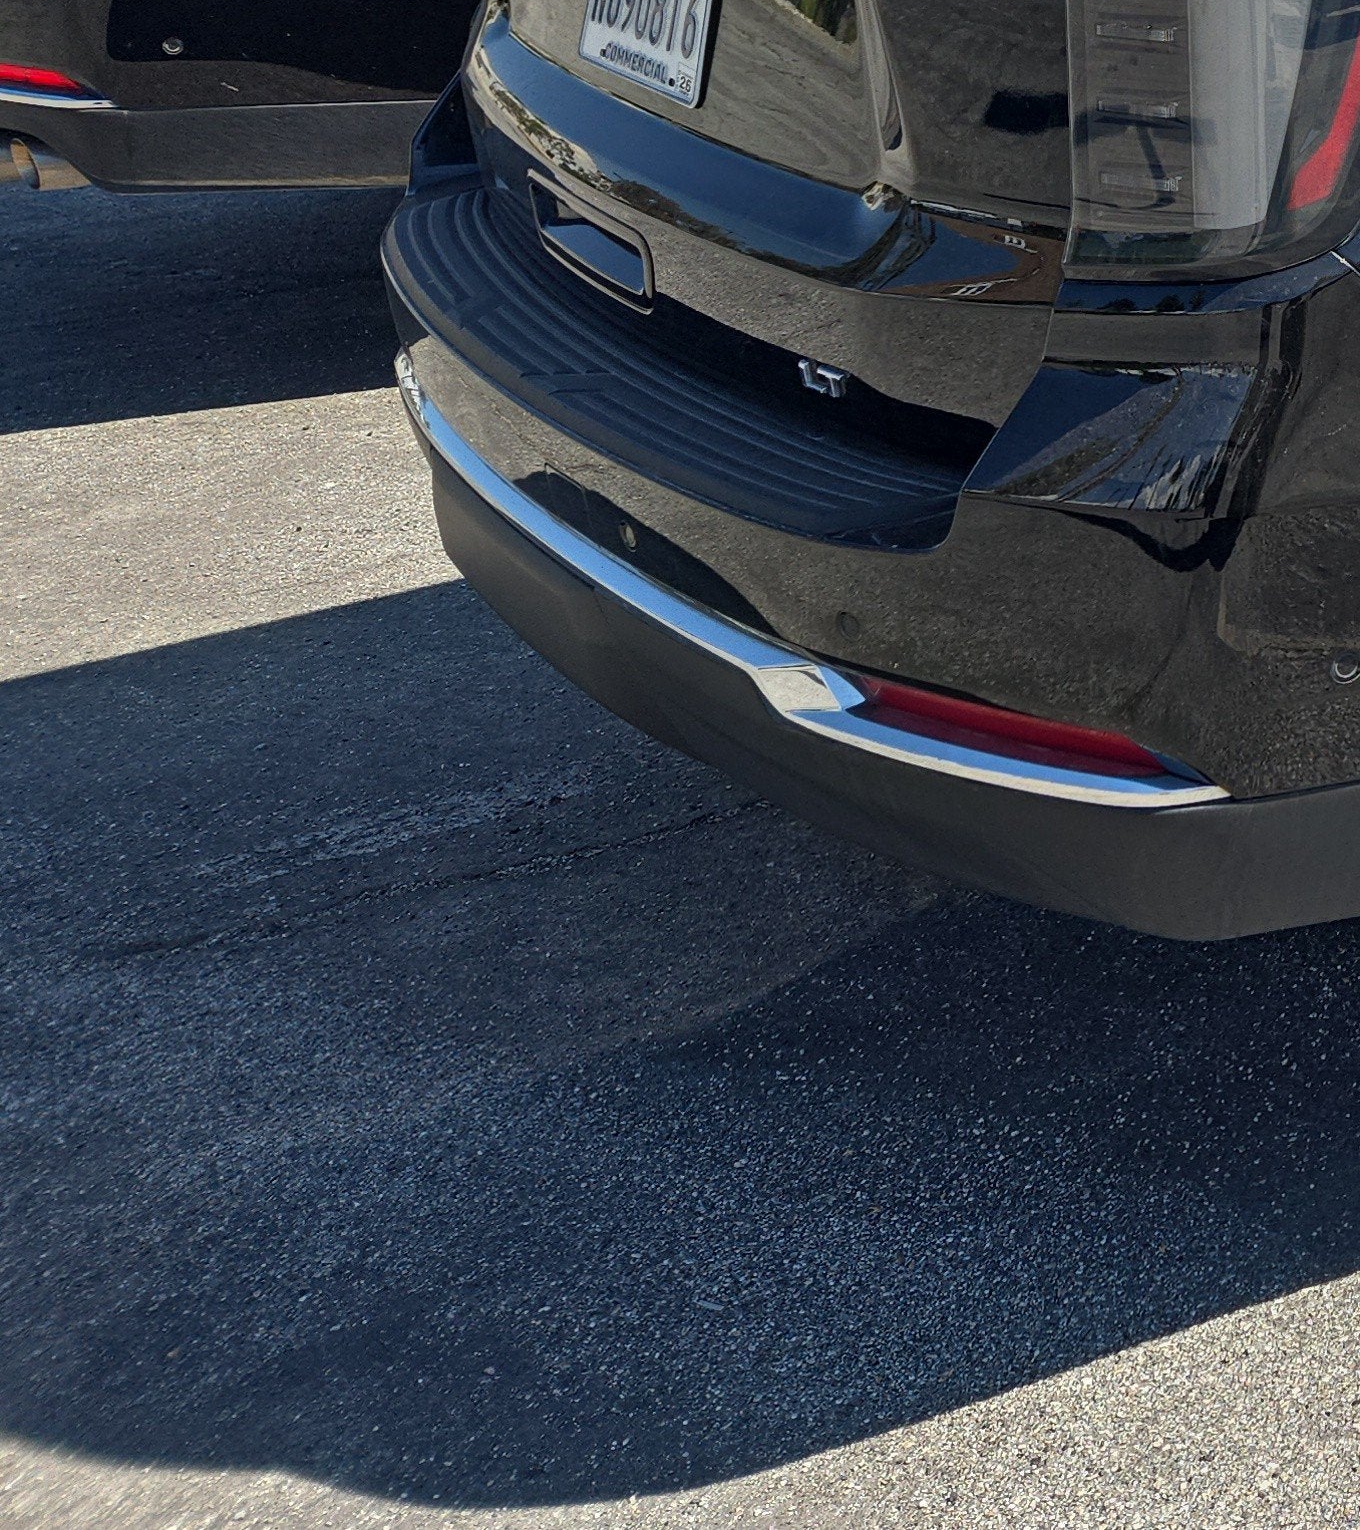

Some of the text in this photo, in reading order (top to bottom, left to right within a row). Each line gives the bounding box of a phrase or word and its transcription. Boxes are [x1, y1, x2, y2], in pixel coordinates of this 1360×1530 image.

[604, 41, 667, 85] COMMERCIAL
[680, 76, 692, 93] 26
[798, 359, 847, 398] LT
